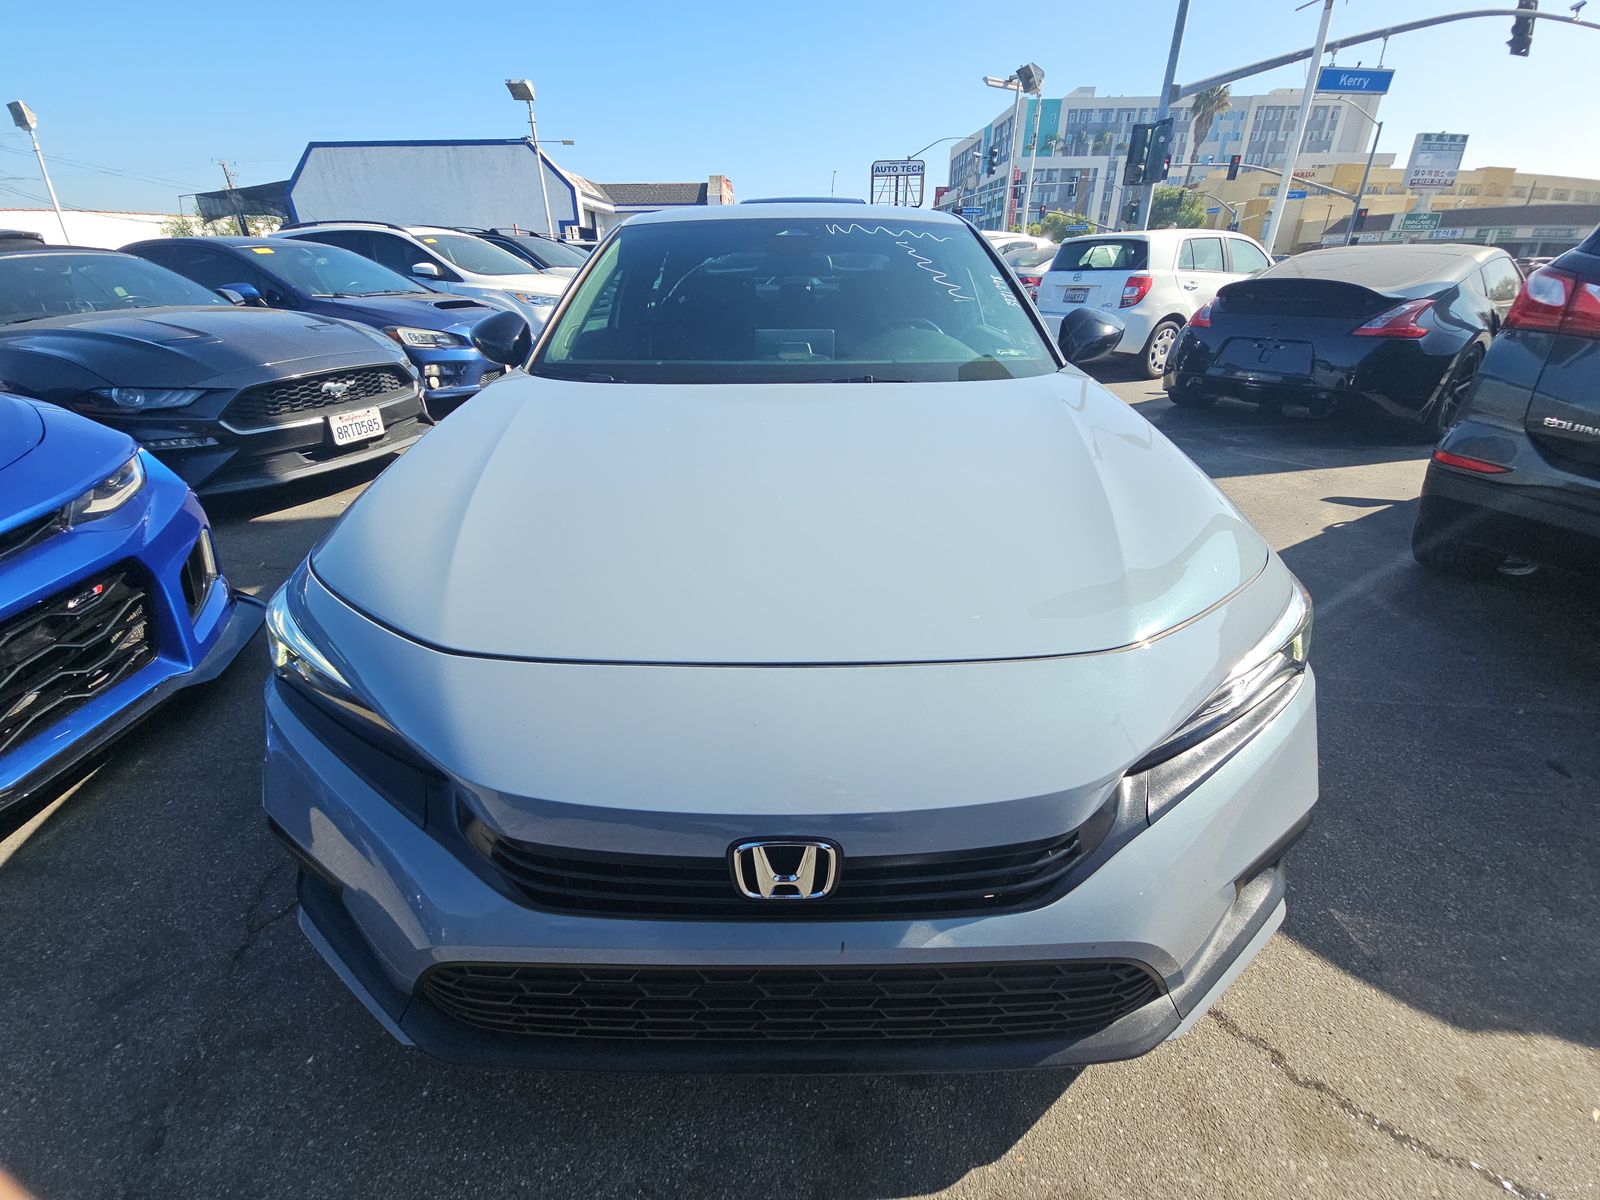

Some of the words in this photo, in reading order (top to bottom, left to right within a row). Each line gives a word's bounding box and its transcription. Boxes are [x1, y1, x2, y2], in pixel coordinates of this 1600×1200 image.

[1339, 73, 1370, 89] Kerry
[874, 165, 898, 173] AUTO
[336, 418, 380, 440] 8RTD585
